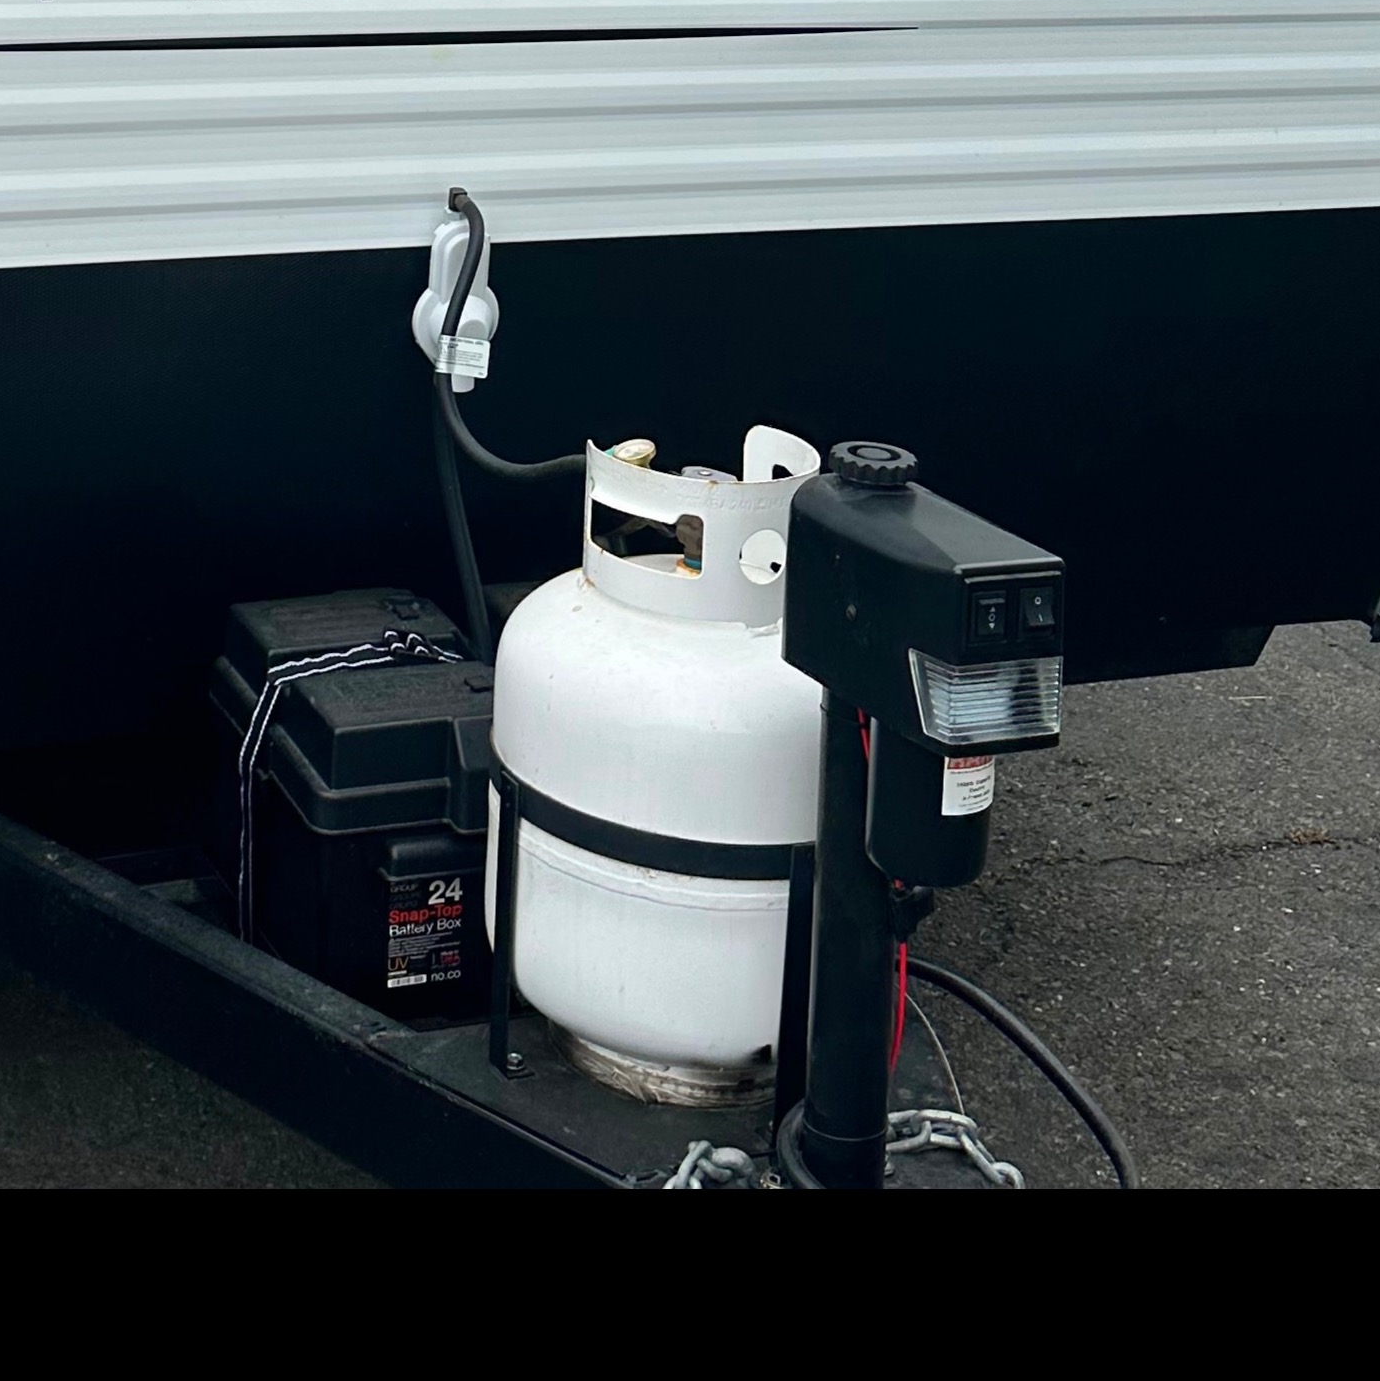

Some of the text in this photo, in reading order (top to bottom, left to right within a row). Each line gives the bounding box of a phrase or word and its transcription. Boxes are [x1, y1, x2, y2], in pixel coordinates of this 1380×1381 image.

[428, 877, 463, 905] 24
[388, 904, 463, 924] Snap-Top
[389, 918, 462, 937] Battery Box
[388, 956, 409, 971] UV
[431, 970, 461, 981] no.co
